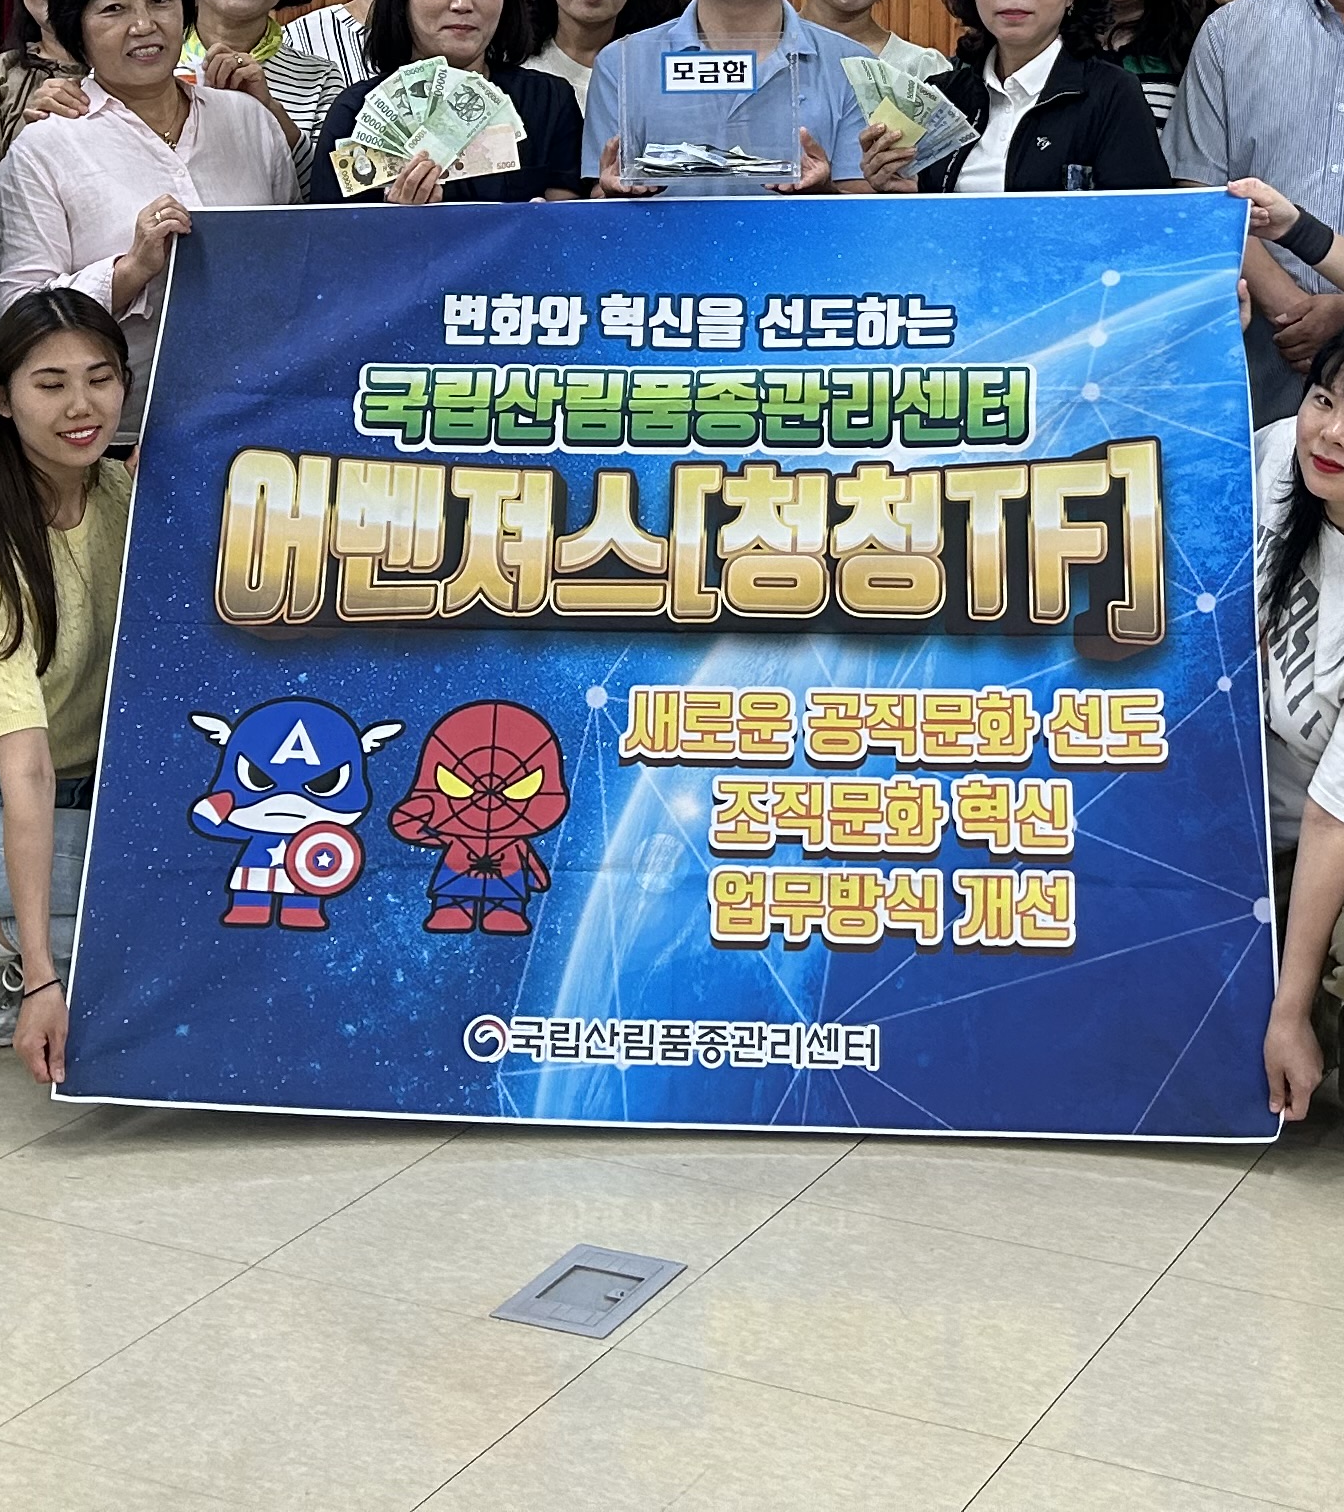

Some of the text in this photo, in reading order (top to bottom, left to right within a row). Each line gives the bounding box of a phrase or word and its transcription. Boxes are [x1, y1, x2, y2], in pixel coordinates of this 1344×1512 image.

[672, 60, 747, 84] 모금함
[443, 293, 956, 349] 변화와 혁신을 선도하는
[359, 365, 1033, 449] 국립산림품종관리센터
[216, 438, 1165, 644] 어벤져스[청청TF]
[621, 687, 1167, 763] 새로운 공직문화 선도
[709, 776, 1073, 854] 조직문화 혁신
[709, 869, 1074, 947] 업무방식 개선
[510, 1017, 881, 1069] 국립산림품종관리센터
